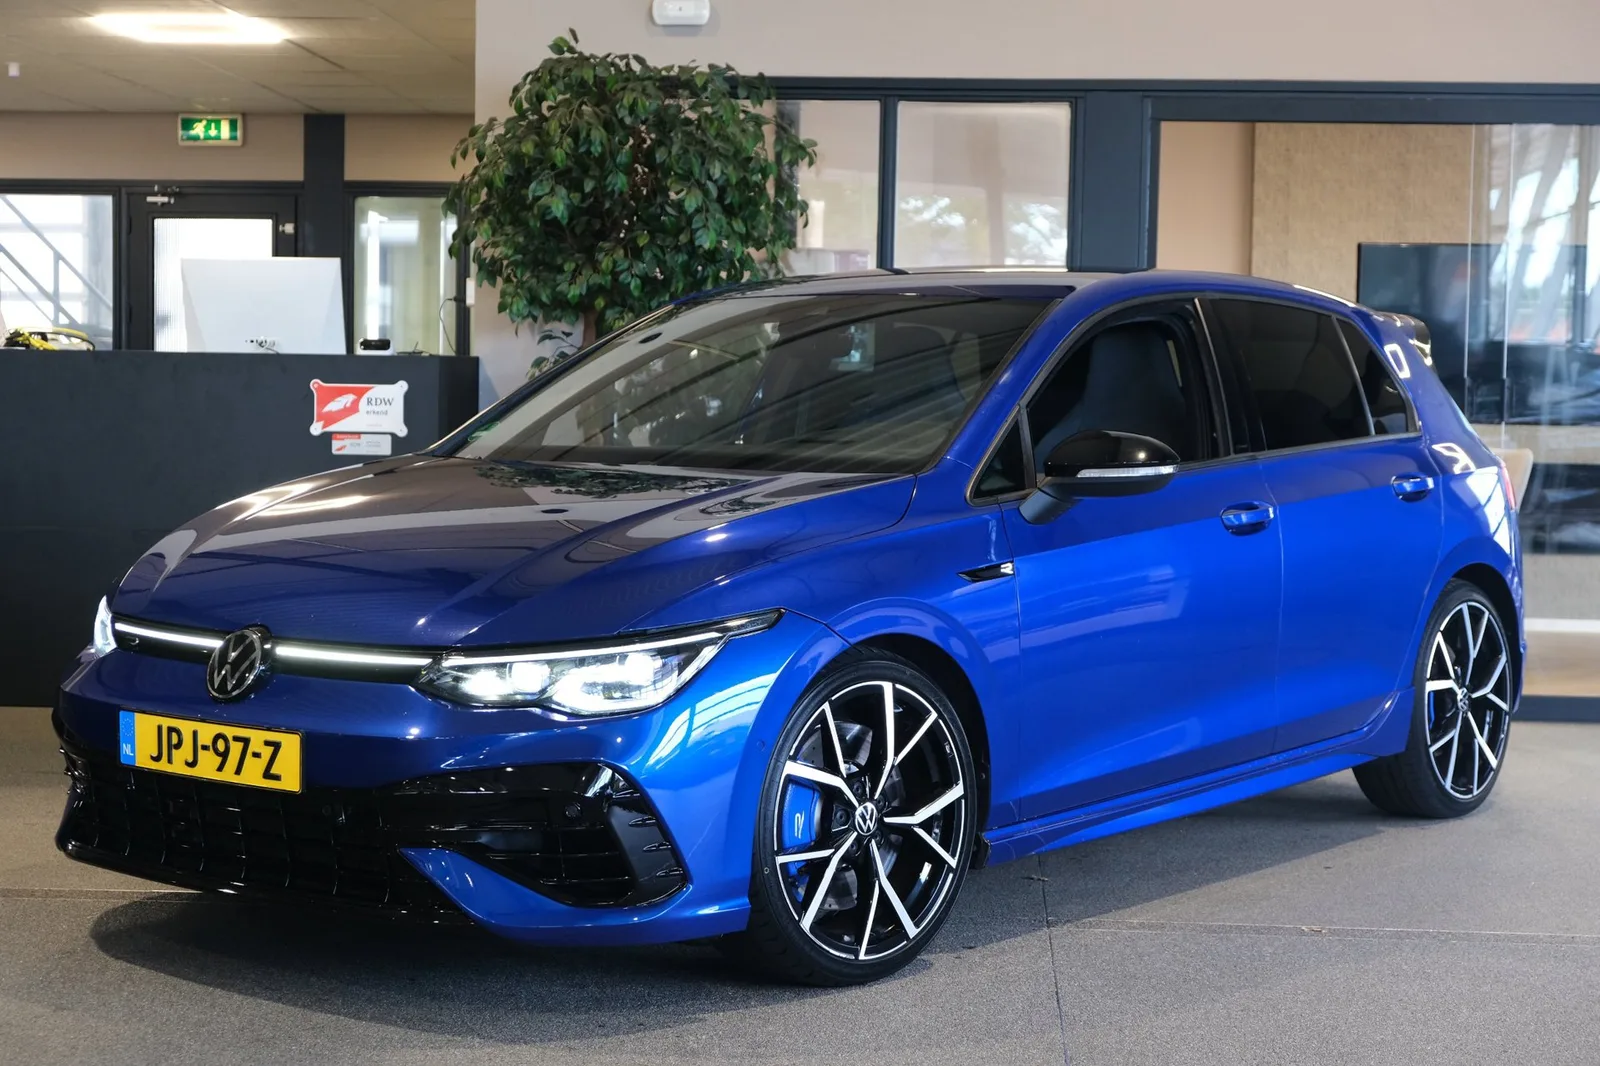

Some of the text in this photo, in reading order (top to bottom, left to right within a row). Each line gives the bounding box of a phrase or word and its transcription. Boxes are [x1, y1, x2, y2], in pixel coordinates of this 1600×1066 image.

[366, 397, 394, 406] RDW
[1000, 562, 1014, 574] R
[122, 743, 134, 756] NL
[150, 724, 282, 782] JPJ-97-Z
